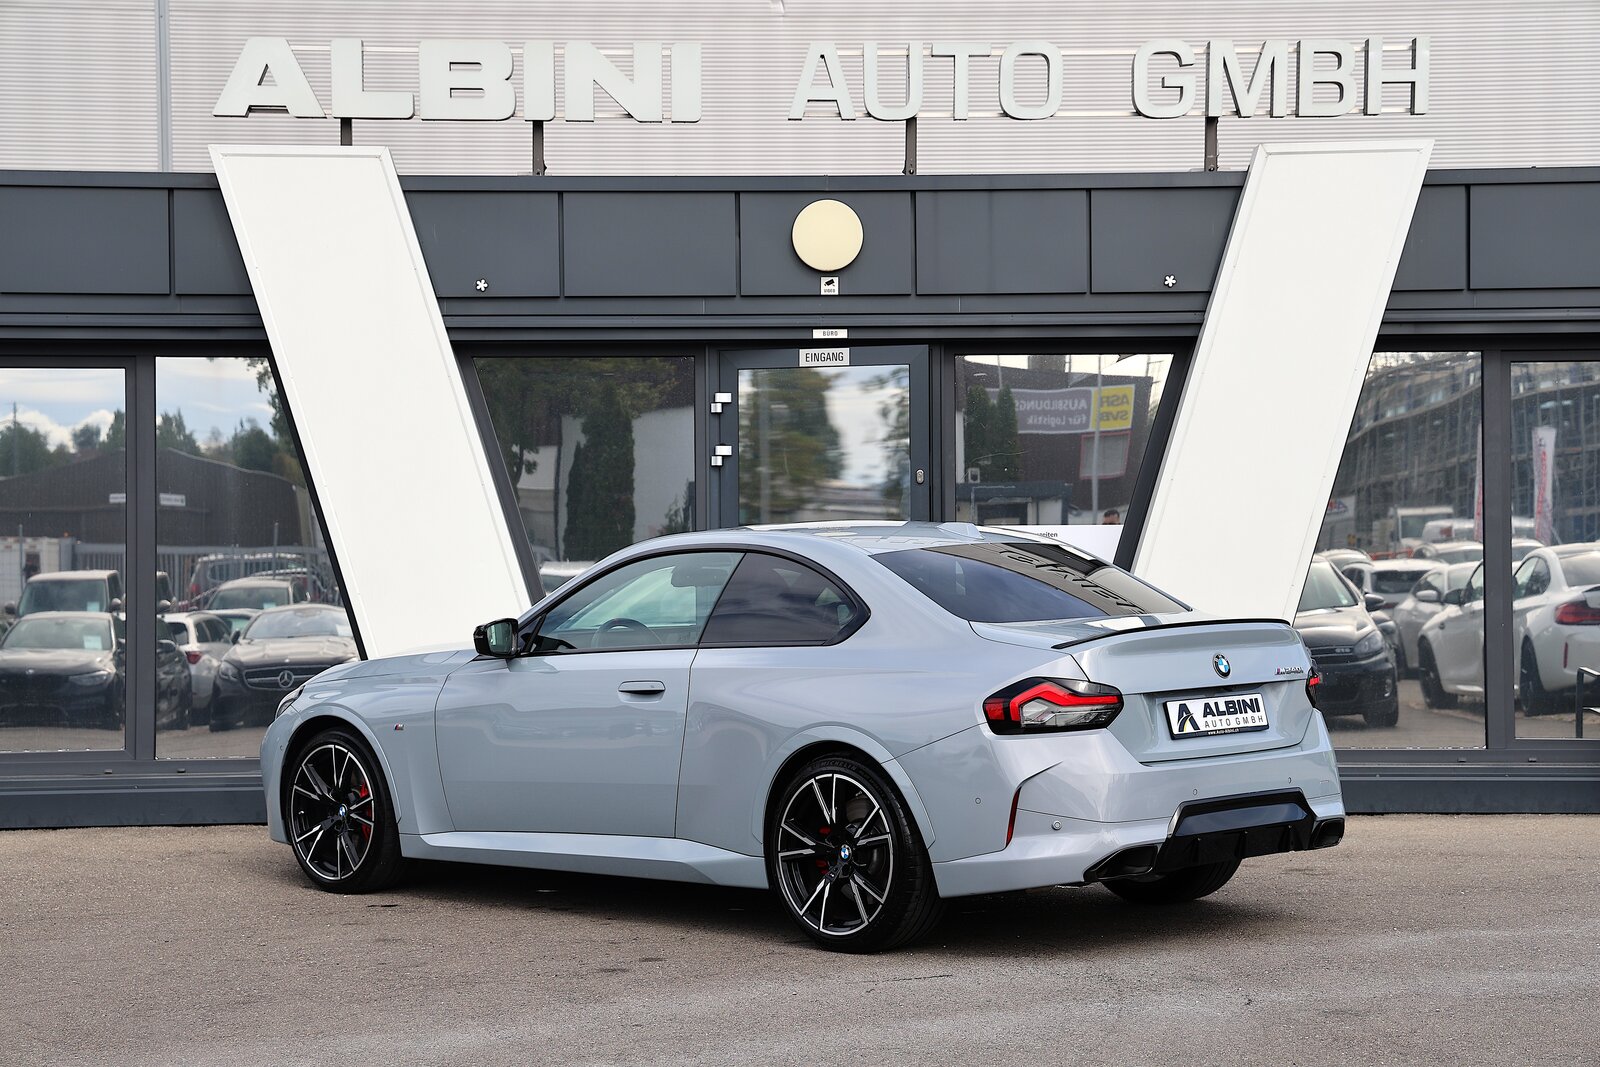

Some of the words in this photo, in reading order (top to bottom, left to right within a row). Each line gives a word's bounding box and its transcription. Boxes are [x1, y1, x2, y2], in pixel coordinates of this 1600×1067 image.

[212, 37, 702, 123] ALBINI
[788, 40, 1063, 121] AUTO
[1132, 37, 1430, 120] GMBH
[805, 351, 844, 363] EINGANG
[1203, 698, 1261, 718] ALBINI
[1204, 718, 1231, 729] AUTO
[1235, 715, 1264, 726] GMBH
[821, 761, 857, 771] MICHELIN
